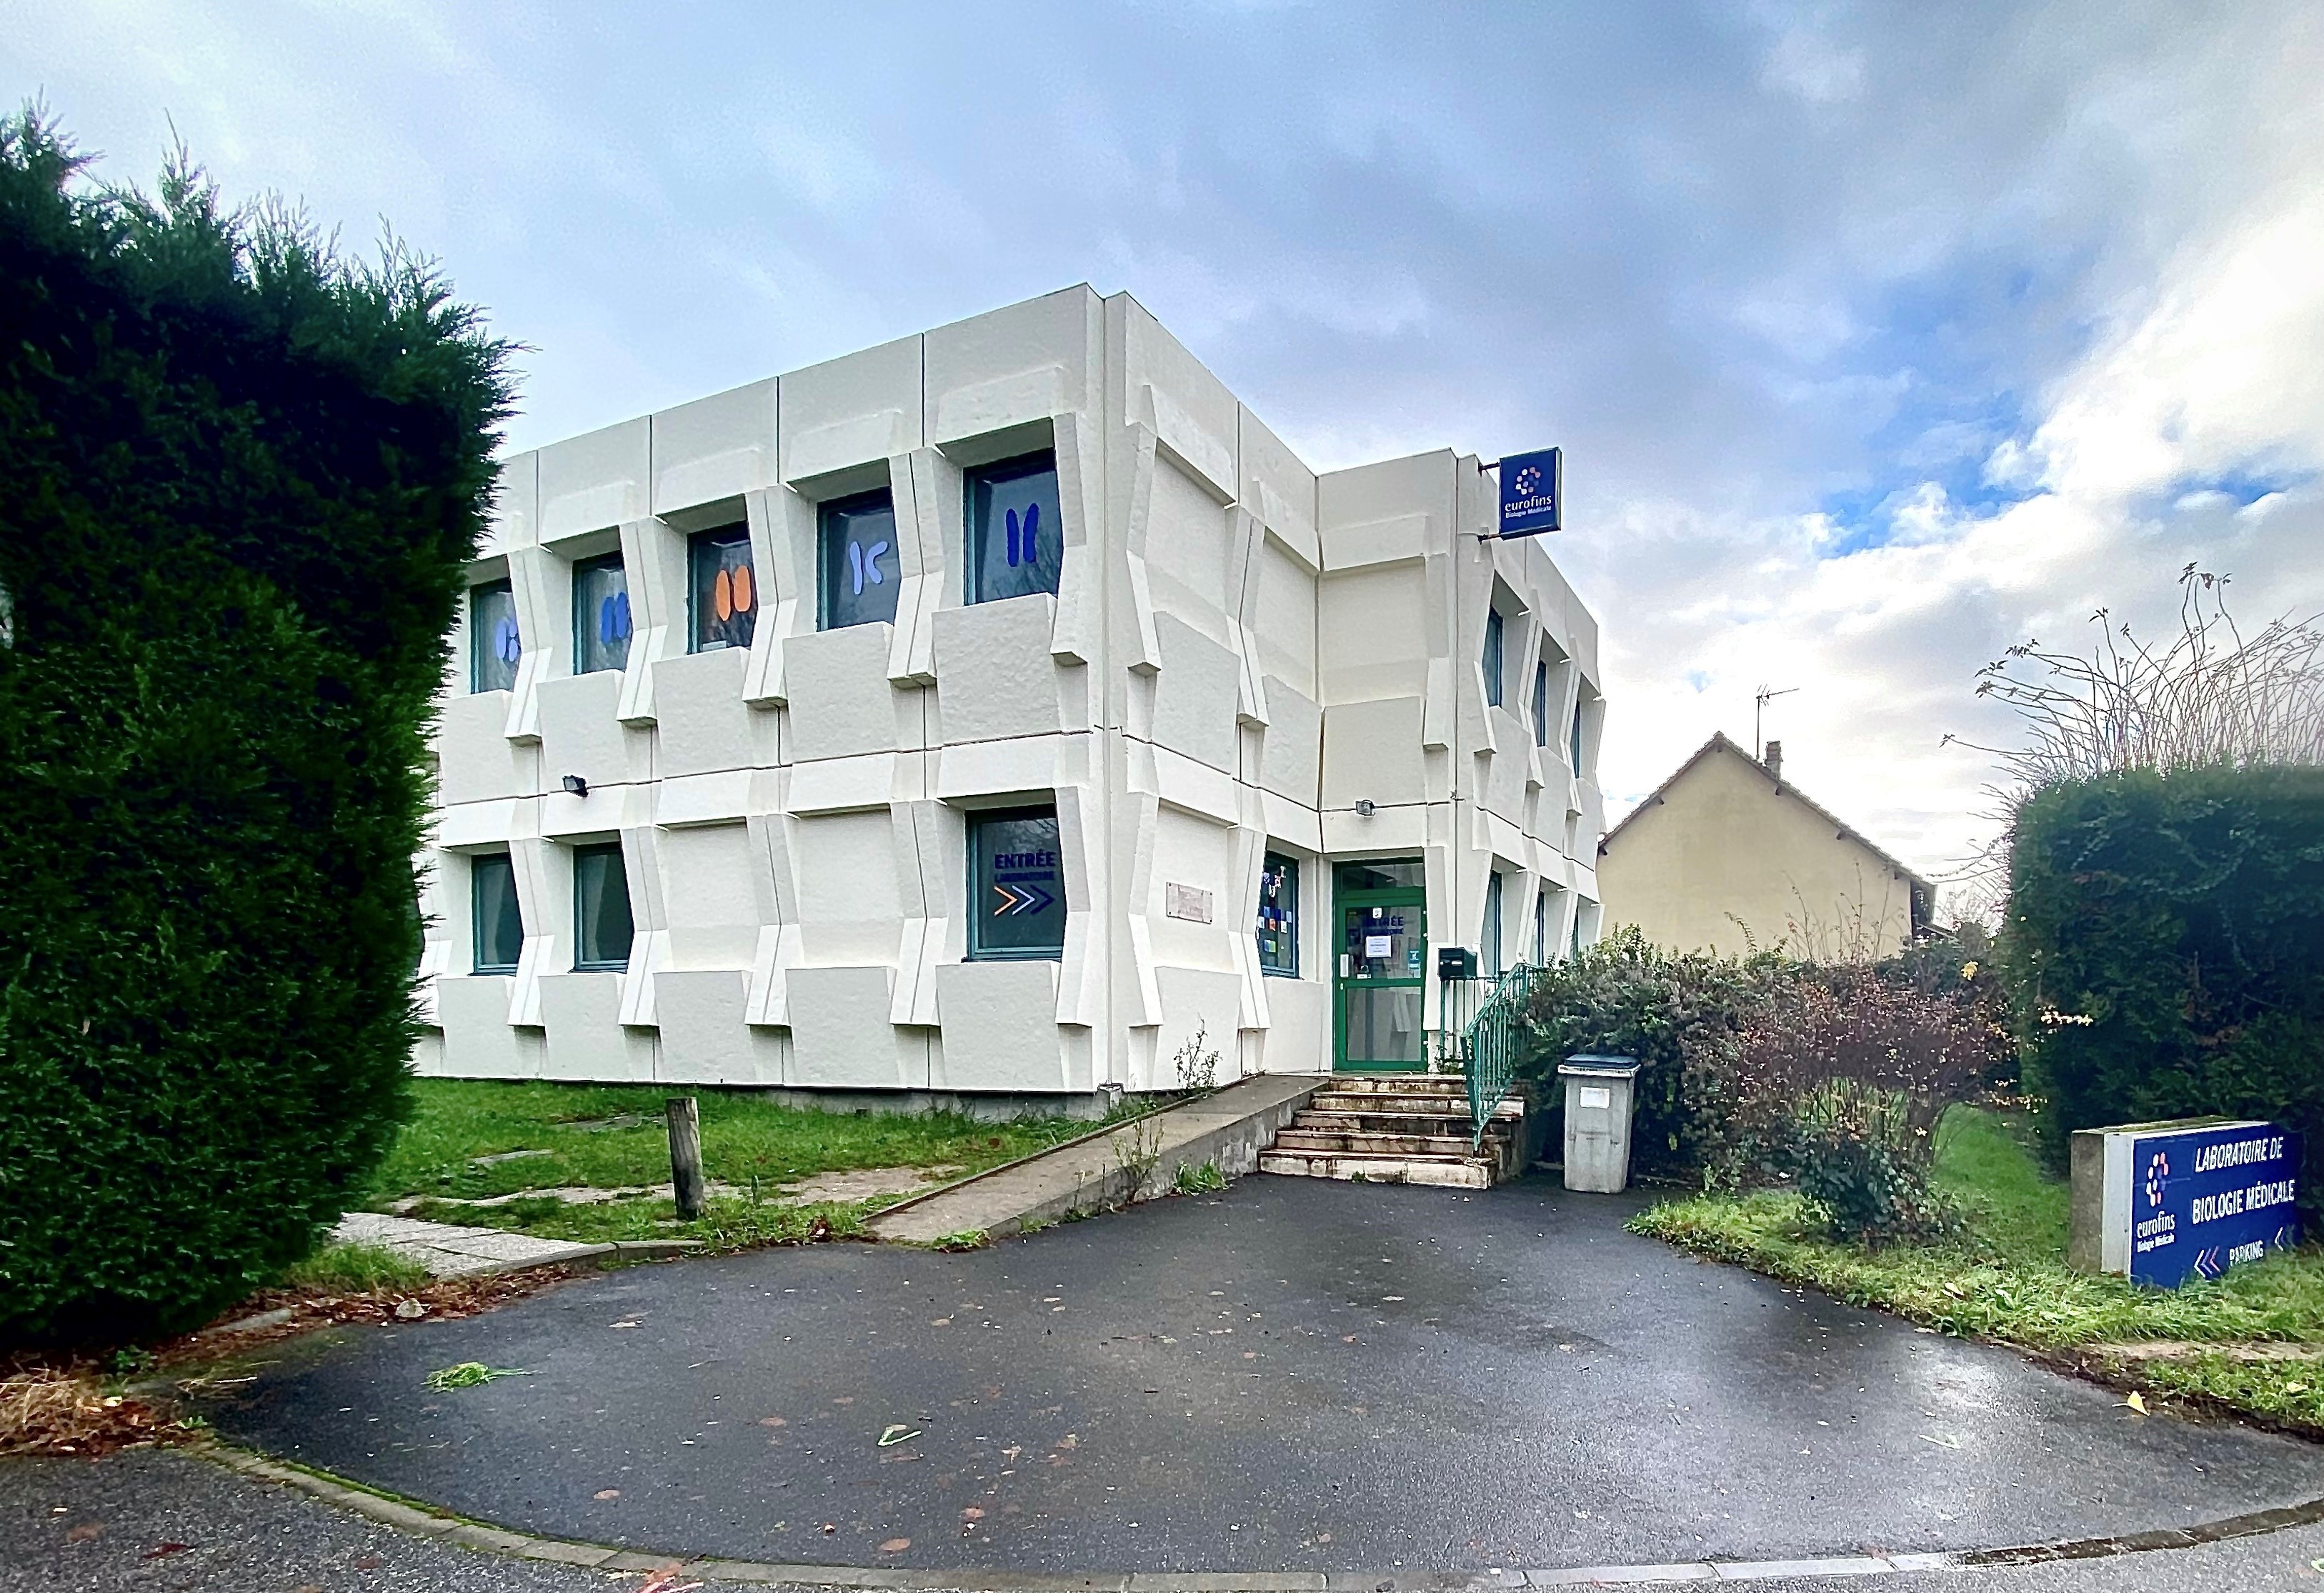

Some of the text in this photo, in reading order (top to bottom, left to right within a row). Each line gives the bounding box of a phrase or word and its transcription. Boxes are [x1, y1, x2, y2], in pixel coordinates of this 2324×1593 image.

[1505, 495, 1552, 511] eurofins
[994, 848, 1057, 869] ENTRÉE
[2195, 1136, 2284, 1172] LABORATOIRE DE
[2193, 1179, 2295, 1224] BIOLOGIE MÉDICALE
[2137, 1210, 2175, 1239] eurofins
[2229, 1239, 2263, 1267] PARKING
